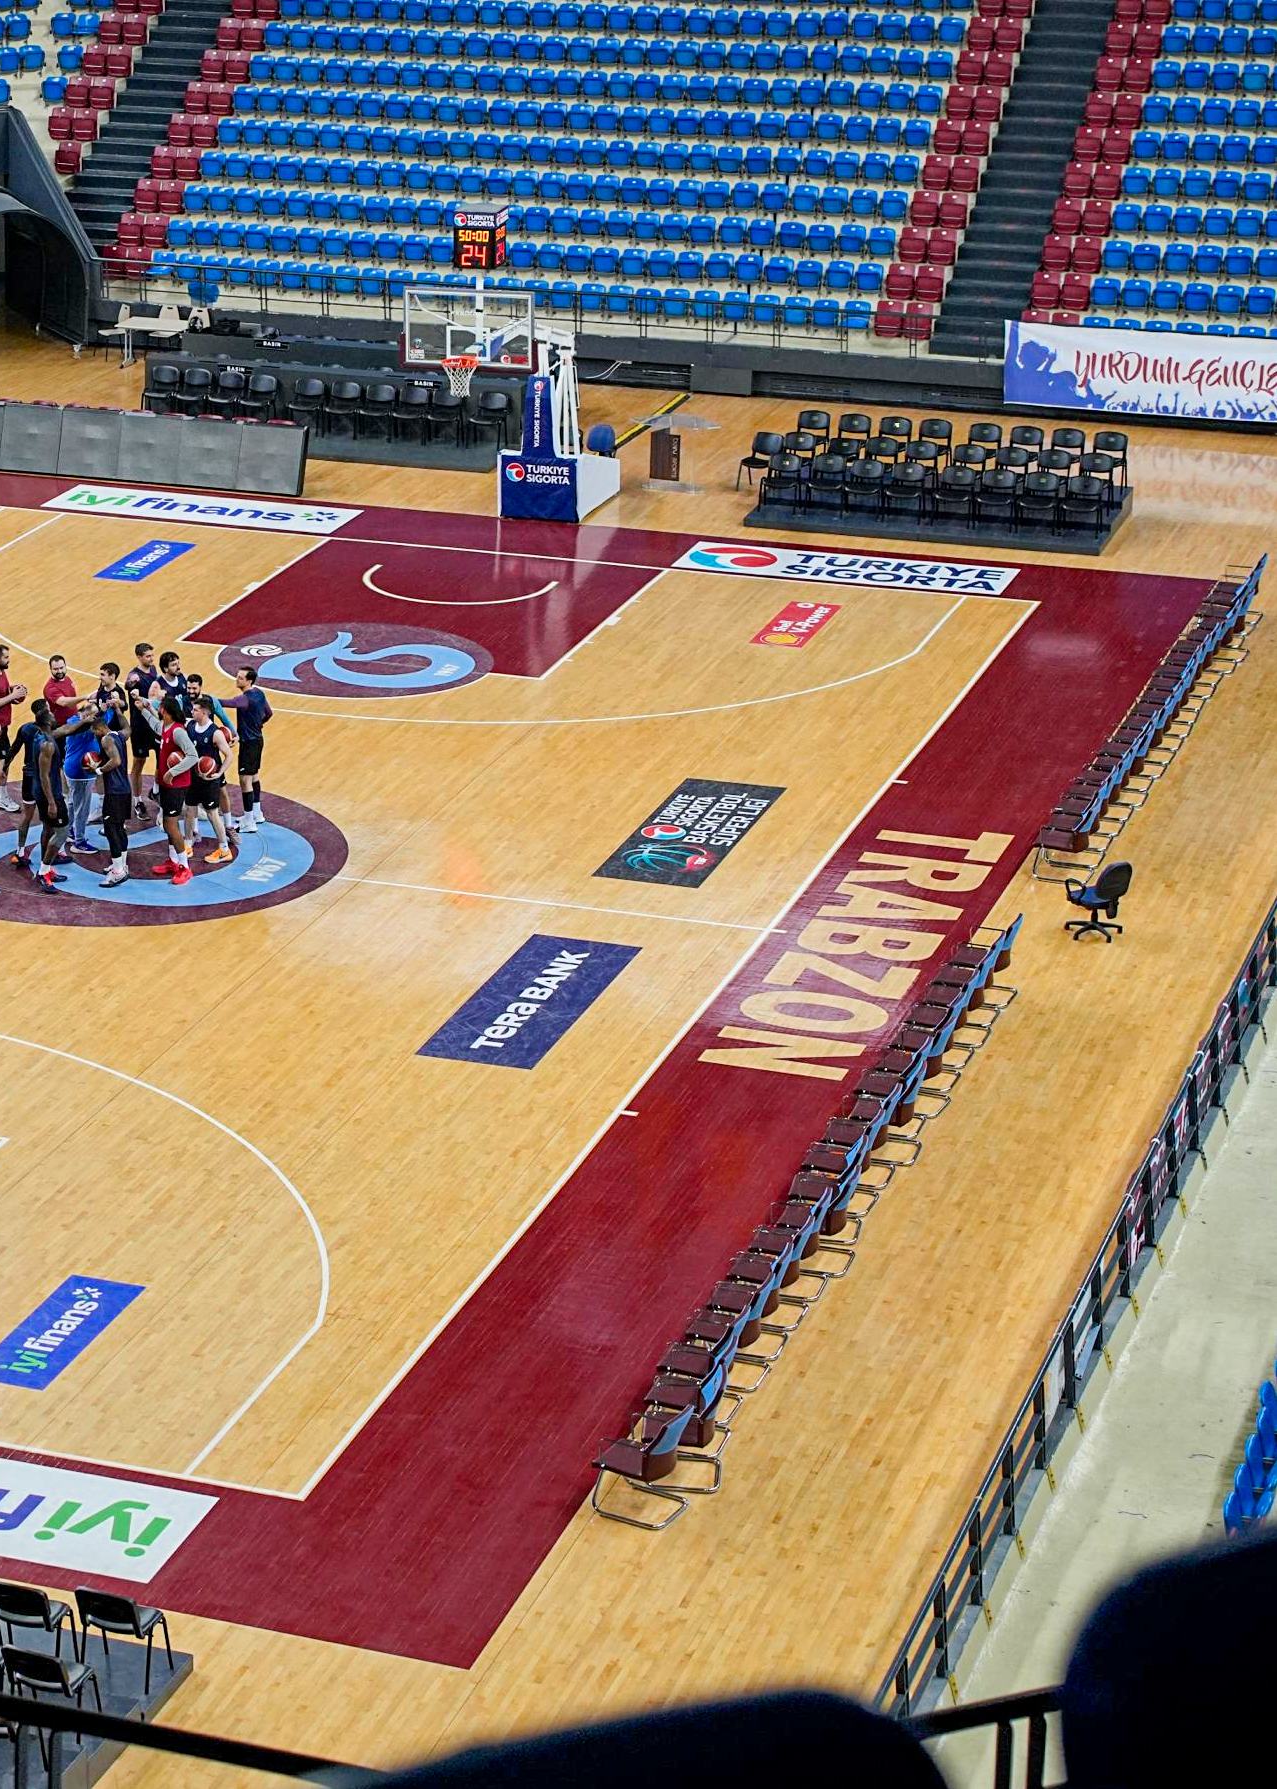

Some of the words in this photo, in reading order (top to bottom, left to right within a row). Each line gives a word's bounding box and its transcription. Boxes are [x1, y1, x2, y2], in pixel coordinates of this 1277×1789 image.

[458, 229, 490, 242] 50:00
[461, 244, 487, 266] 24
[1075, 350, 1180, 389] YURDUM
[682, 792, 749, 844] BASKETBOL
[709, 815, 755, 847] SÜPER
[518, 949, 591, 1001] BANK
[697, 829, 1016, 1081] TRABZON
[23, 1299, 100, 1353] finans
[32, 1498, 173, 1559] iyi
